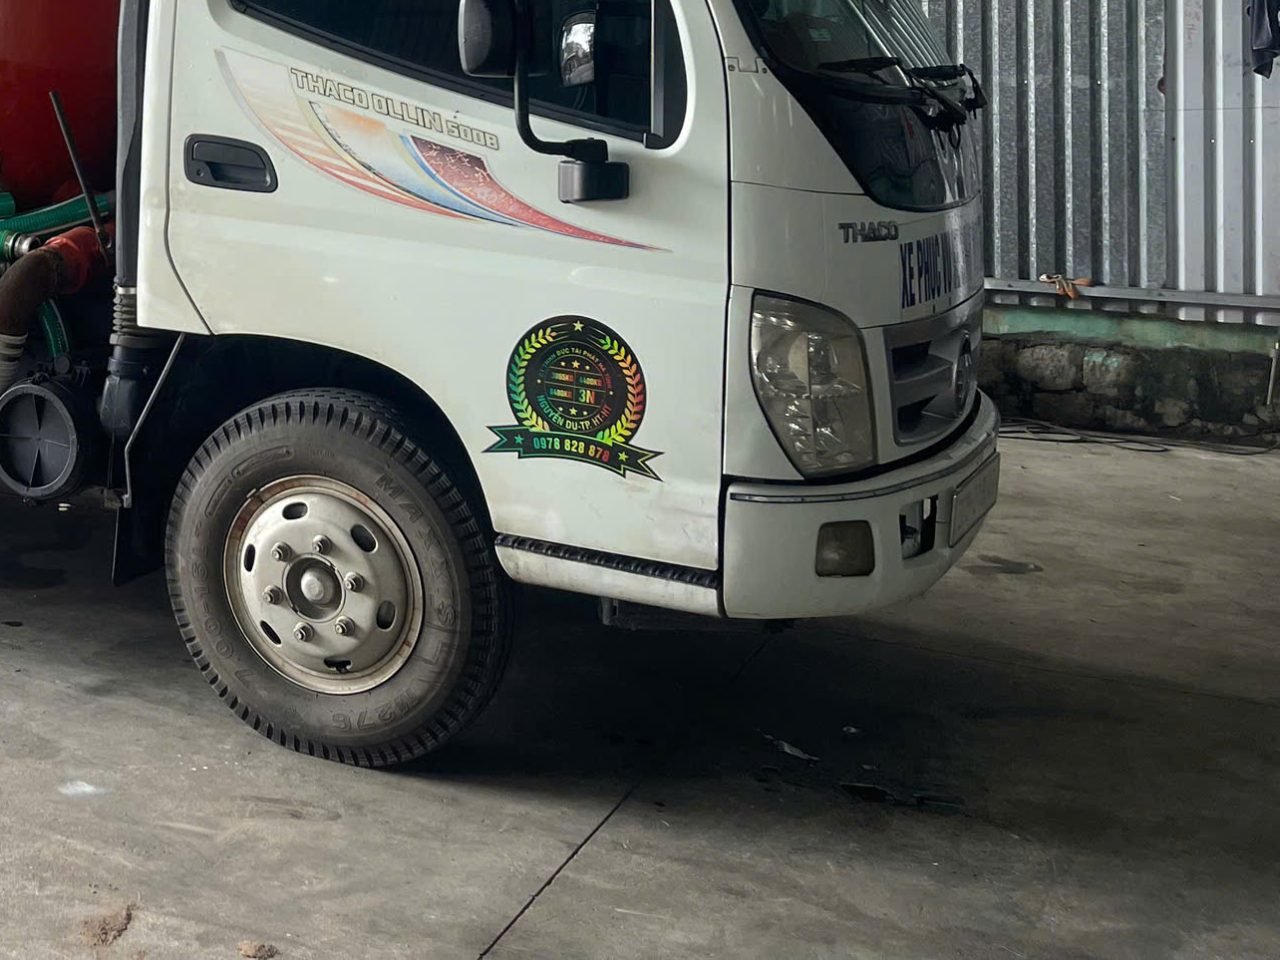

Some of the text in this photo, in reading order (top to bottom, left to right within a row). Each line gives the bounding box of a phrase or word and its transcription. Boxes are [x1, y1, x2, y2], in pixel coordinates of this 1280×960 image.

[291, 67, 370, 110] THACO
[372, 93, 444, 134] OLLIN
[838, 220, 899, 243] THACO
[900, 241, 916, 310] XE
[578, 389, 596, 404] 3N
[533, 437, 560, 450] 0978
[588, 444, 610, 462] 878
